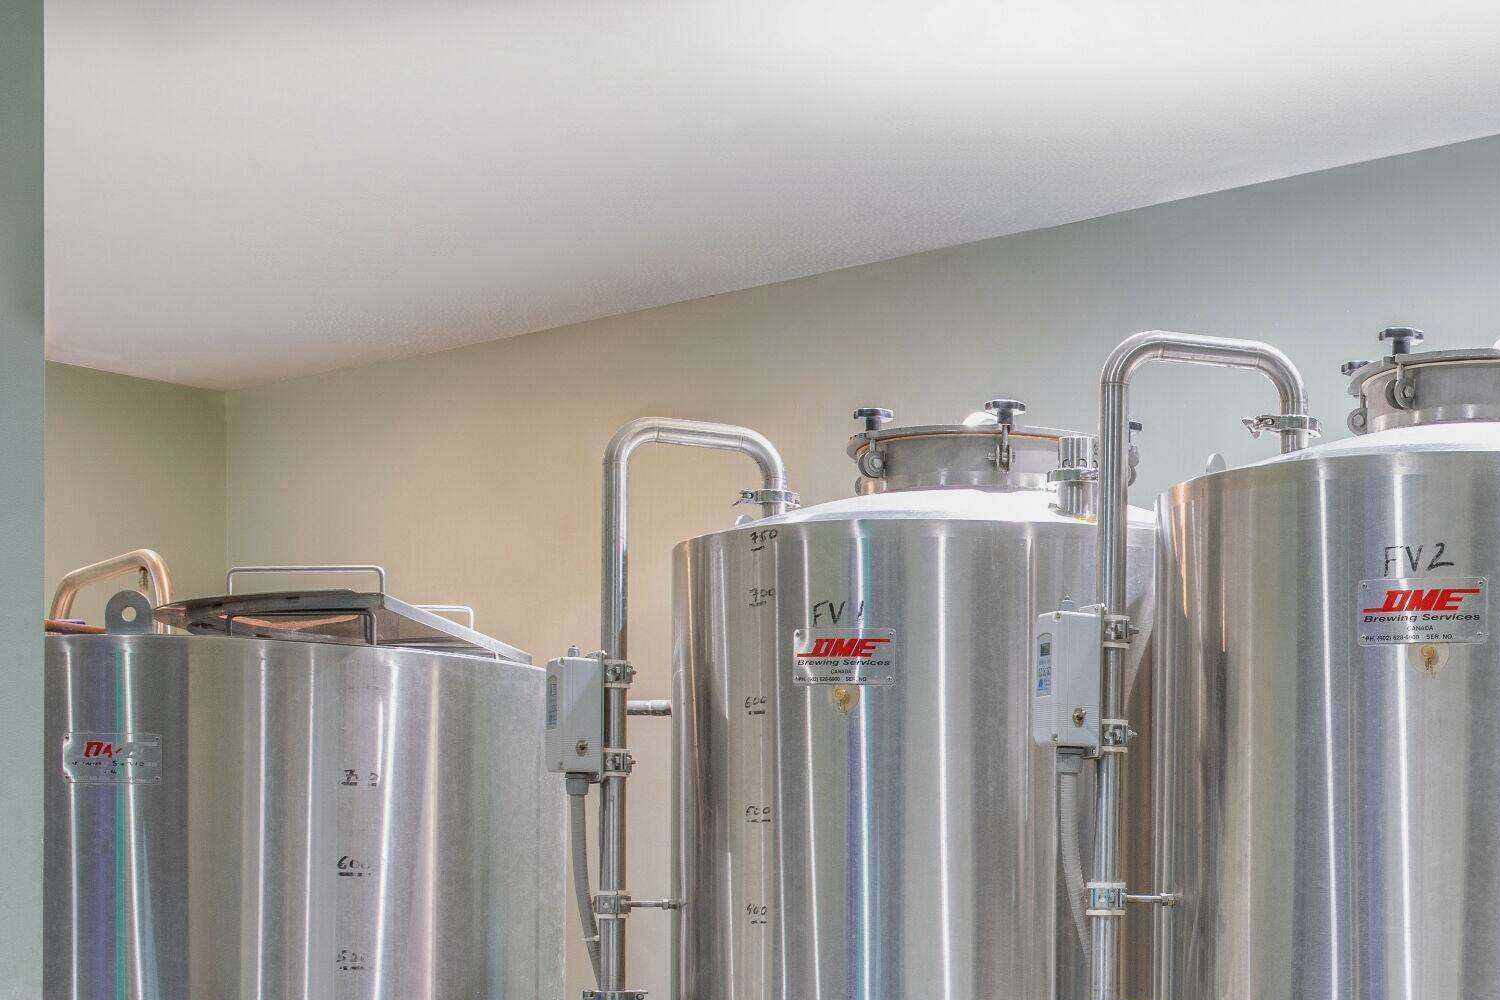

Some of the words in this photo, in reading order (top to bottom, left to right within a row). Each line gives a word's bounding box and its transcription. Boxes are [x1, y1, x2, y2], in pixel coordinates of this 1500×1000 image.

[1363, 588, 1480, 613] DME
[1363, 614, 1418, 623] Brewing
[1421, 613, 1481, 621] Services
[796, 638, 891, 658] DME
